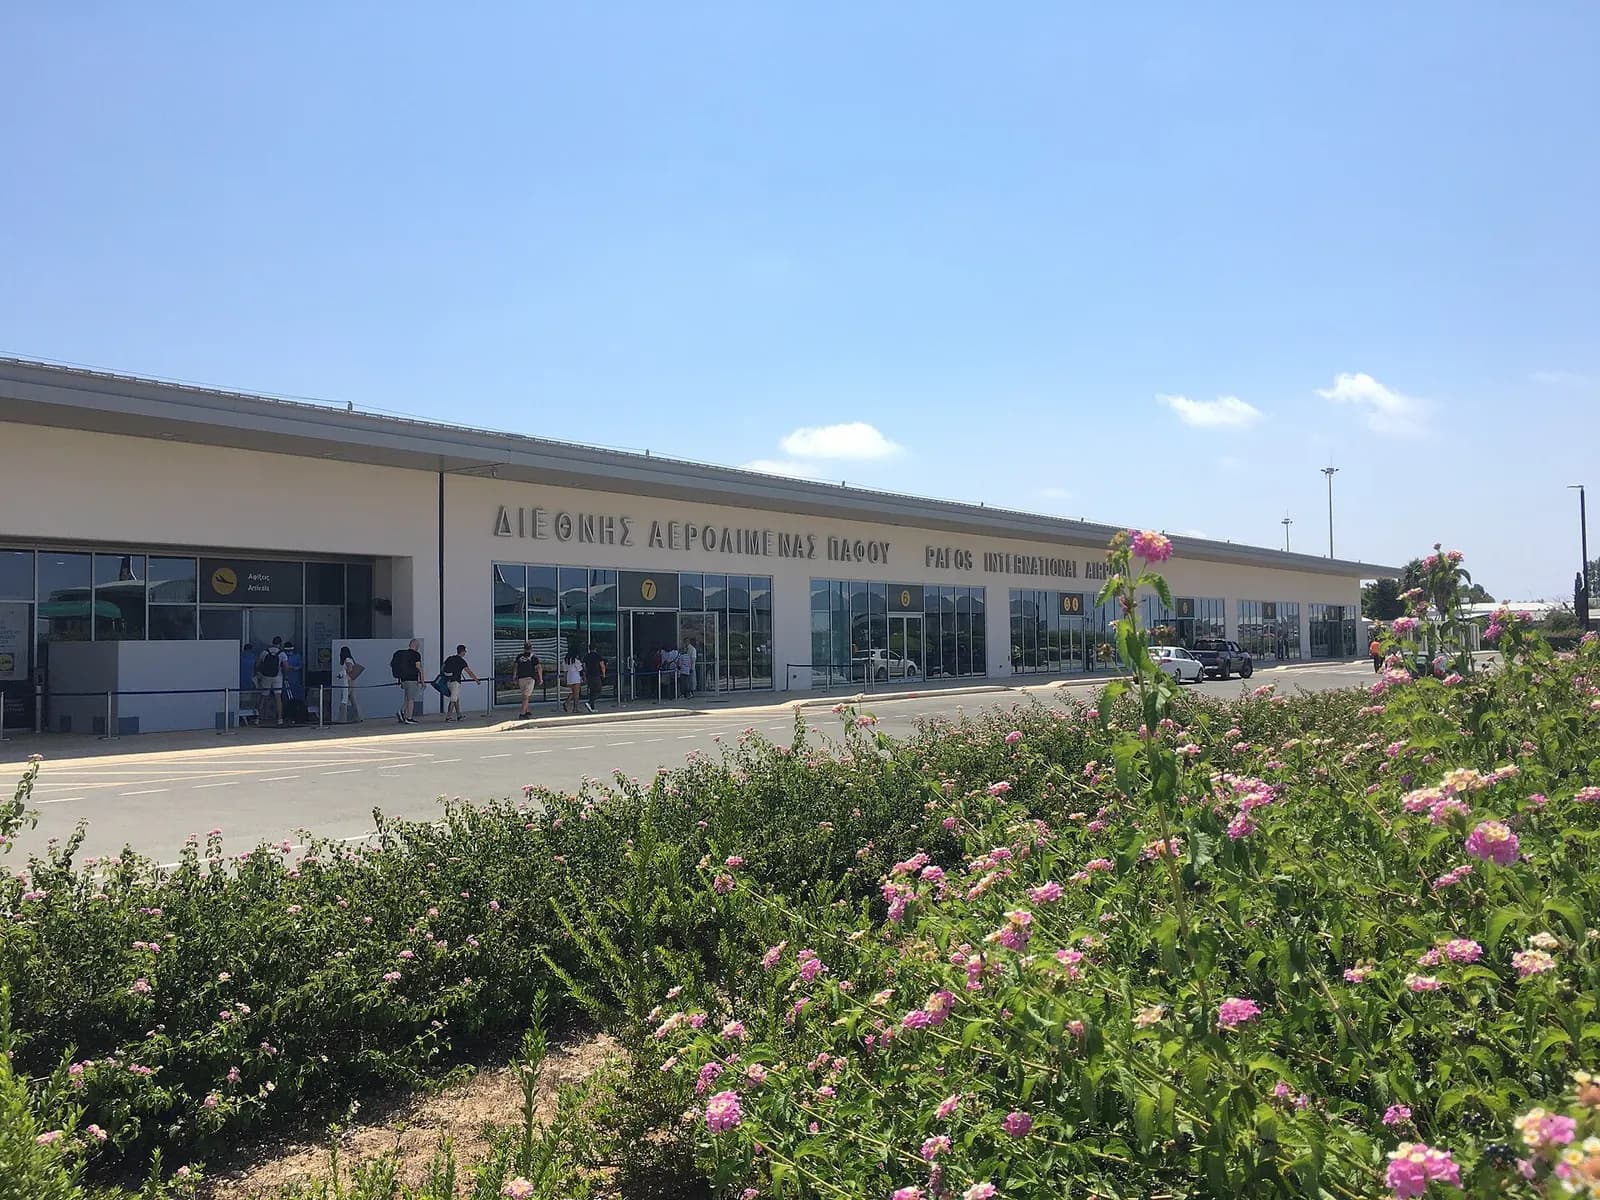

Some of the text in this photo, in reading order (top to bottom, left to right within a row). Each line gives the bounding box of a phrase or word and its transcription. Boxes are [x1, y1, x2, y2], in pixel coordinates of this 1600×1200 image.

[494, 504, 891, 565] ΔΙΕΘΝΗΣ ΑΕΡΟΛΙΜΕΝΑΣ ΠΑΦΟΥ
[925, 545, 973, 571] PAFOS
[984, 551, 1077, 579] INTERNATIONAL
